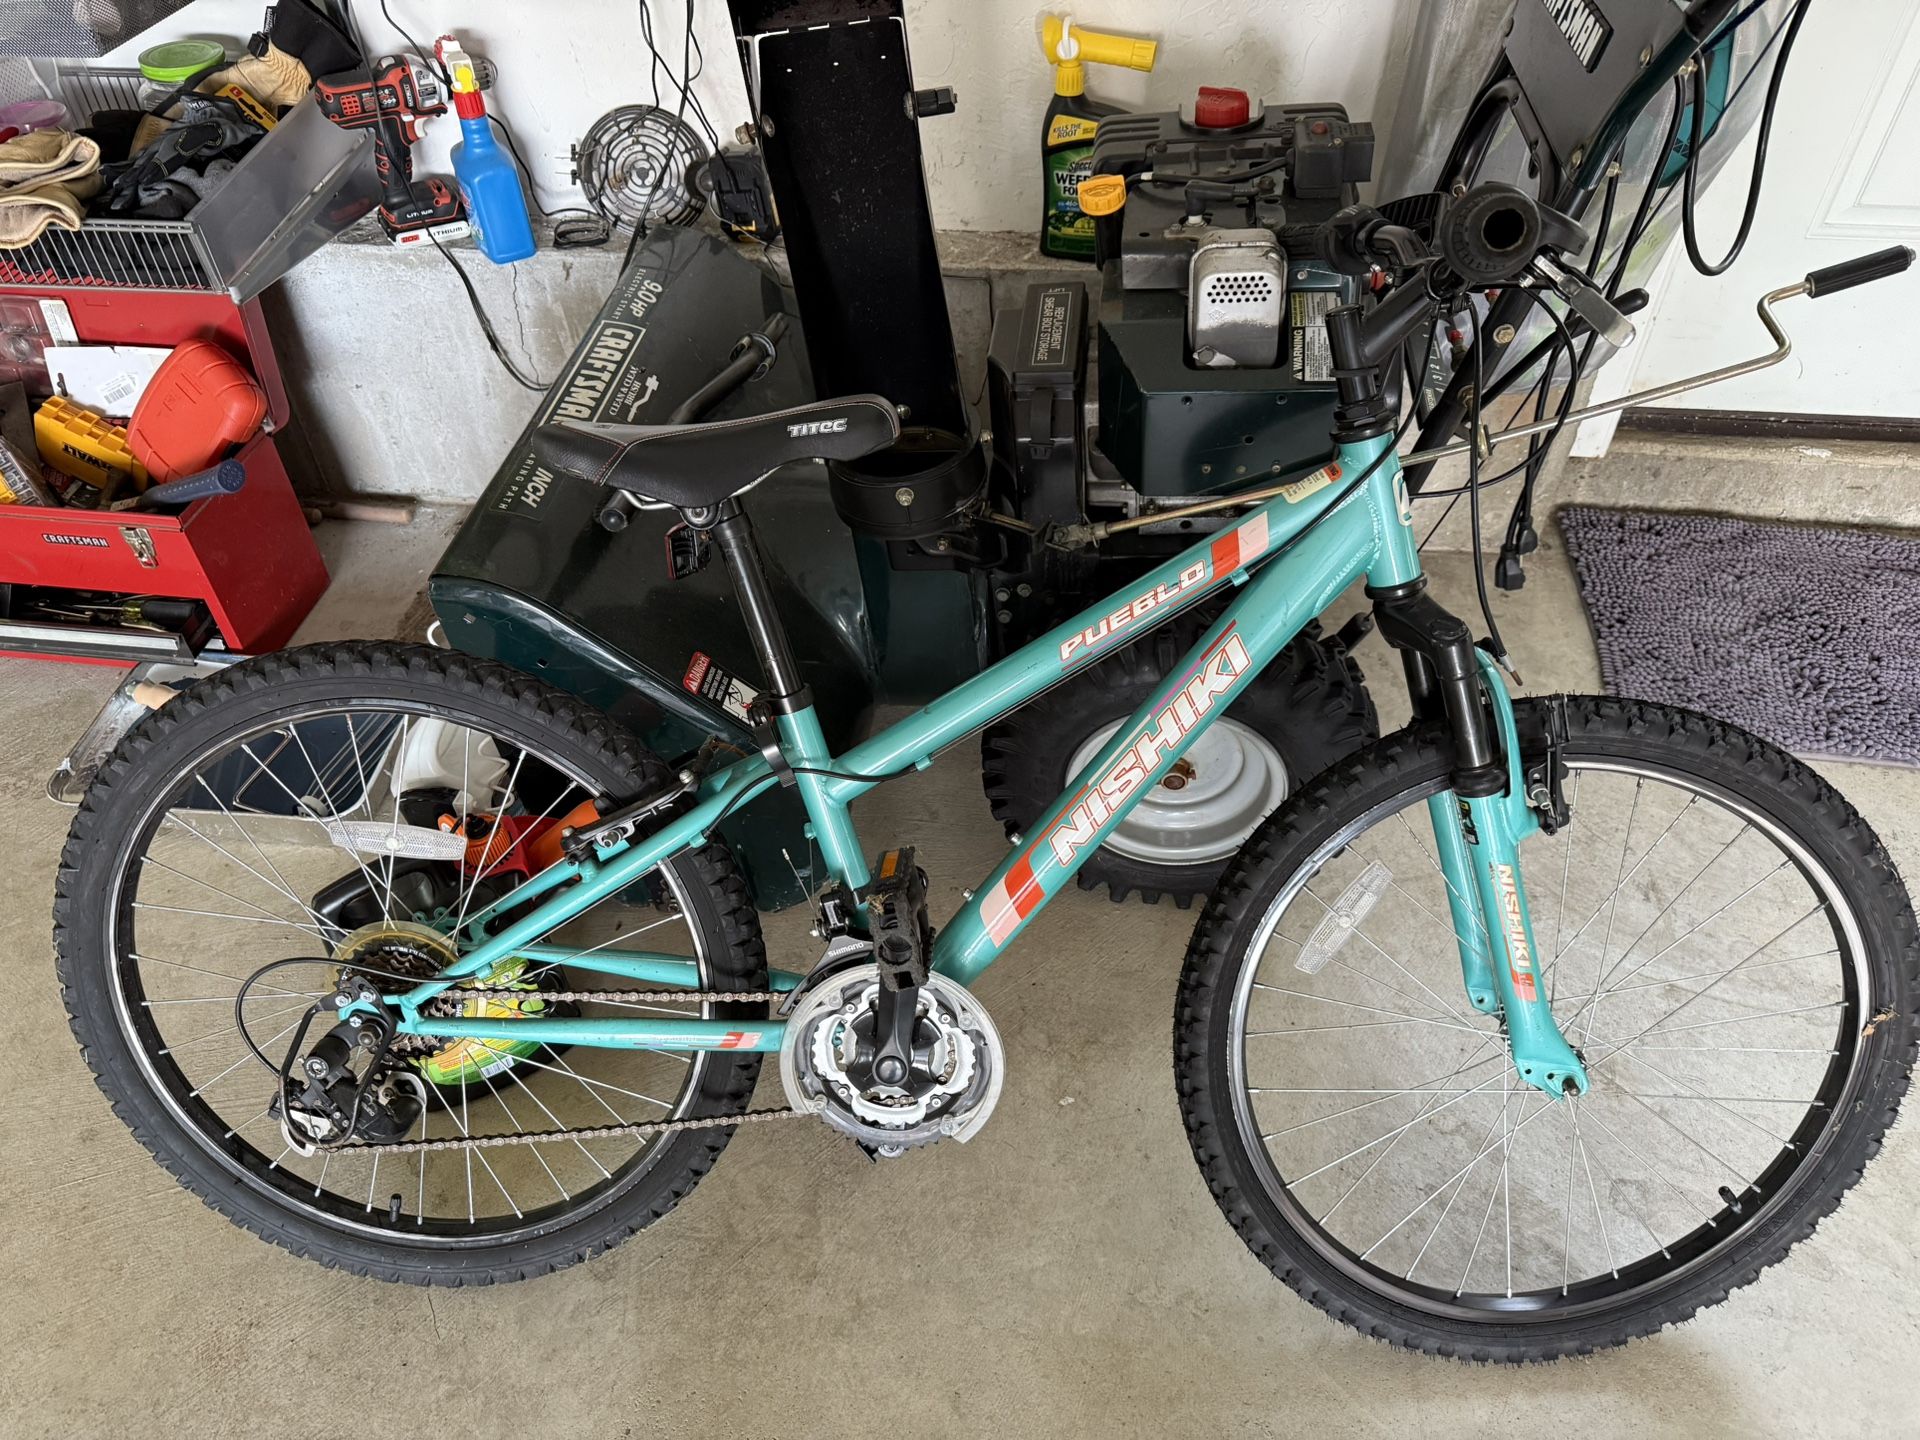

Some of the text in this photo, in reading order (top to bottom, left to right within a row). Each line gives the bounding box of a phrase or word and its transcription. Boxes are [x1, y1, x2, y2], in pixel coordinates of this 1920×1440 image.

[1057, 129, 1077, 139] ROOT
[1063, 187, 1079, 196] FO
[611, 268, 647, 320] ELECTRIC START
[1037, 296, 1055, 361] SHEAR BOLT STORAGE
[1050, 306, 1065, 350] REPLACEMENT
[1293, 329, 1304, 371] WARNING
[609, 392, 623, 416] CLEAN
[624, 380, 642, 406] BRUSH
[498, 453, 536, 510] ARING PATH
[520, 467, 554, 508] INCH
[43, 534, 108, 547] CRAFTSMAN
[1060, 560, 1207, 662] PUEBLO
[688, 655, 710, 684] DANGER
[1050, 633, 1252, 867] NISHIKI
[1497, 863, 1531, 968] NISHIKI
[828, 942, 864, 956] SHIMANO
